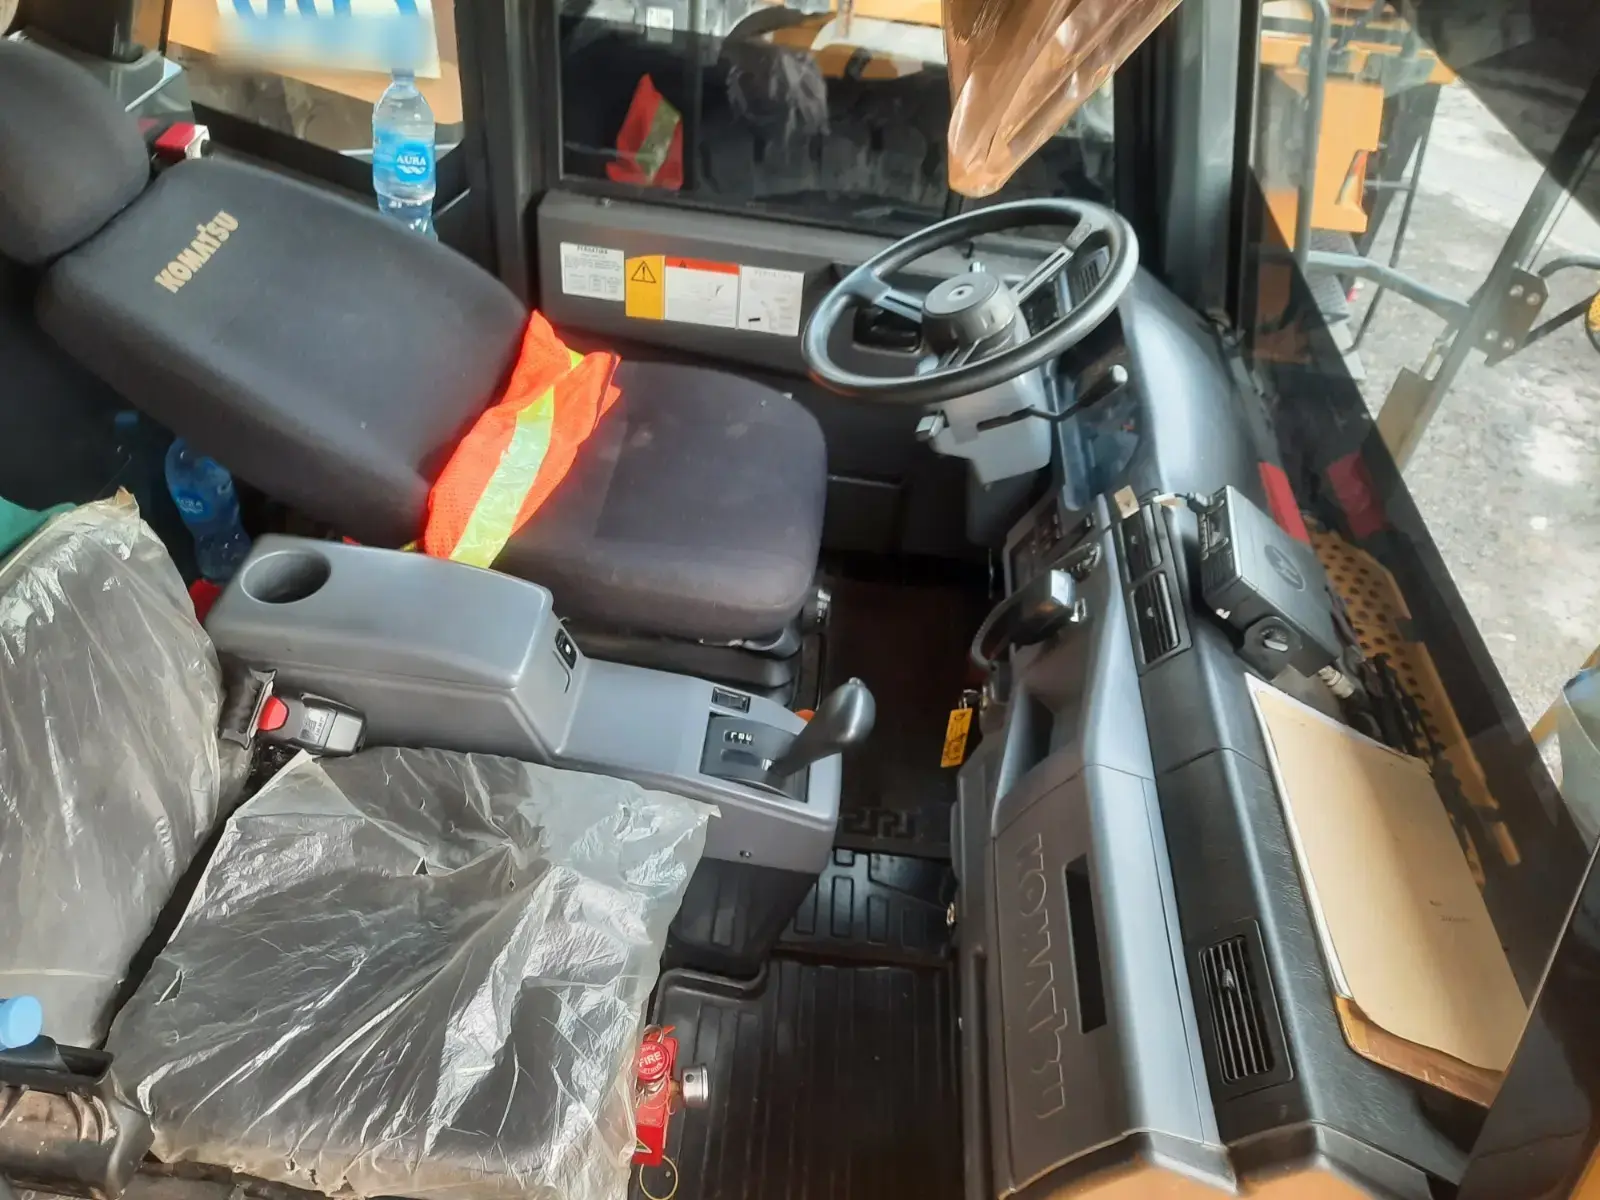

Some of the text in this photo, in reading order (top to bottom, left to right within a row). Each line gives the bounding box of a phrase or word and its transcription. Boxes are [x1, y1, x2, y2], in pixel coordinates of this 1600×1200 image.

[396, 154, 427, 166] AURA
[154, 209, 239, 293] KOMATSU
[1015, 832, 1068, 1120] KOMATSU
[639, 1051, 663, 1068] FIRE
